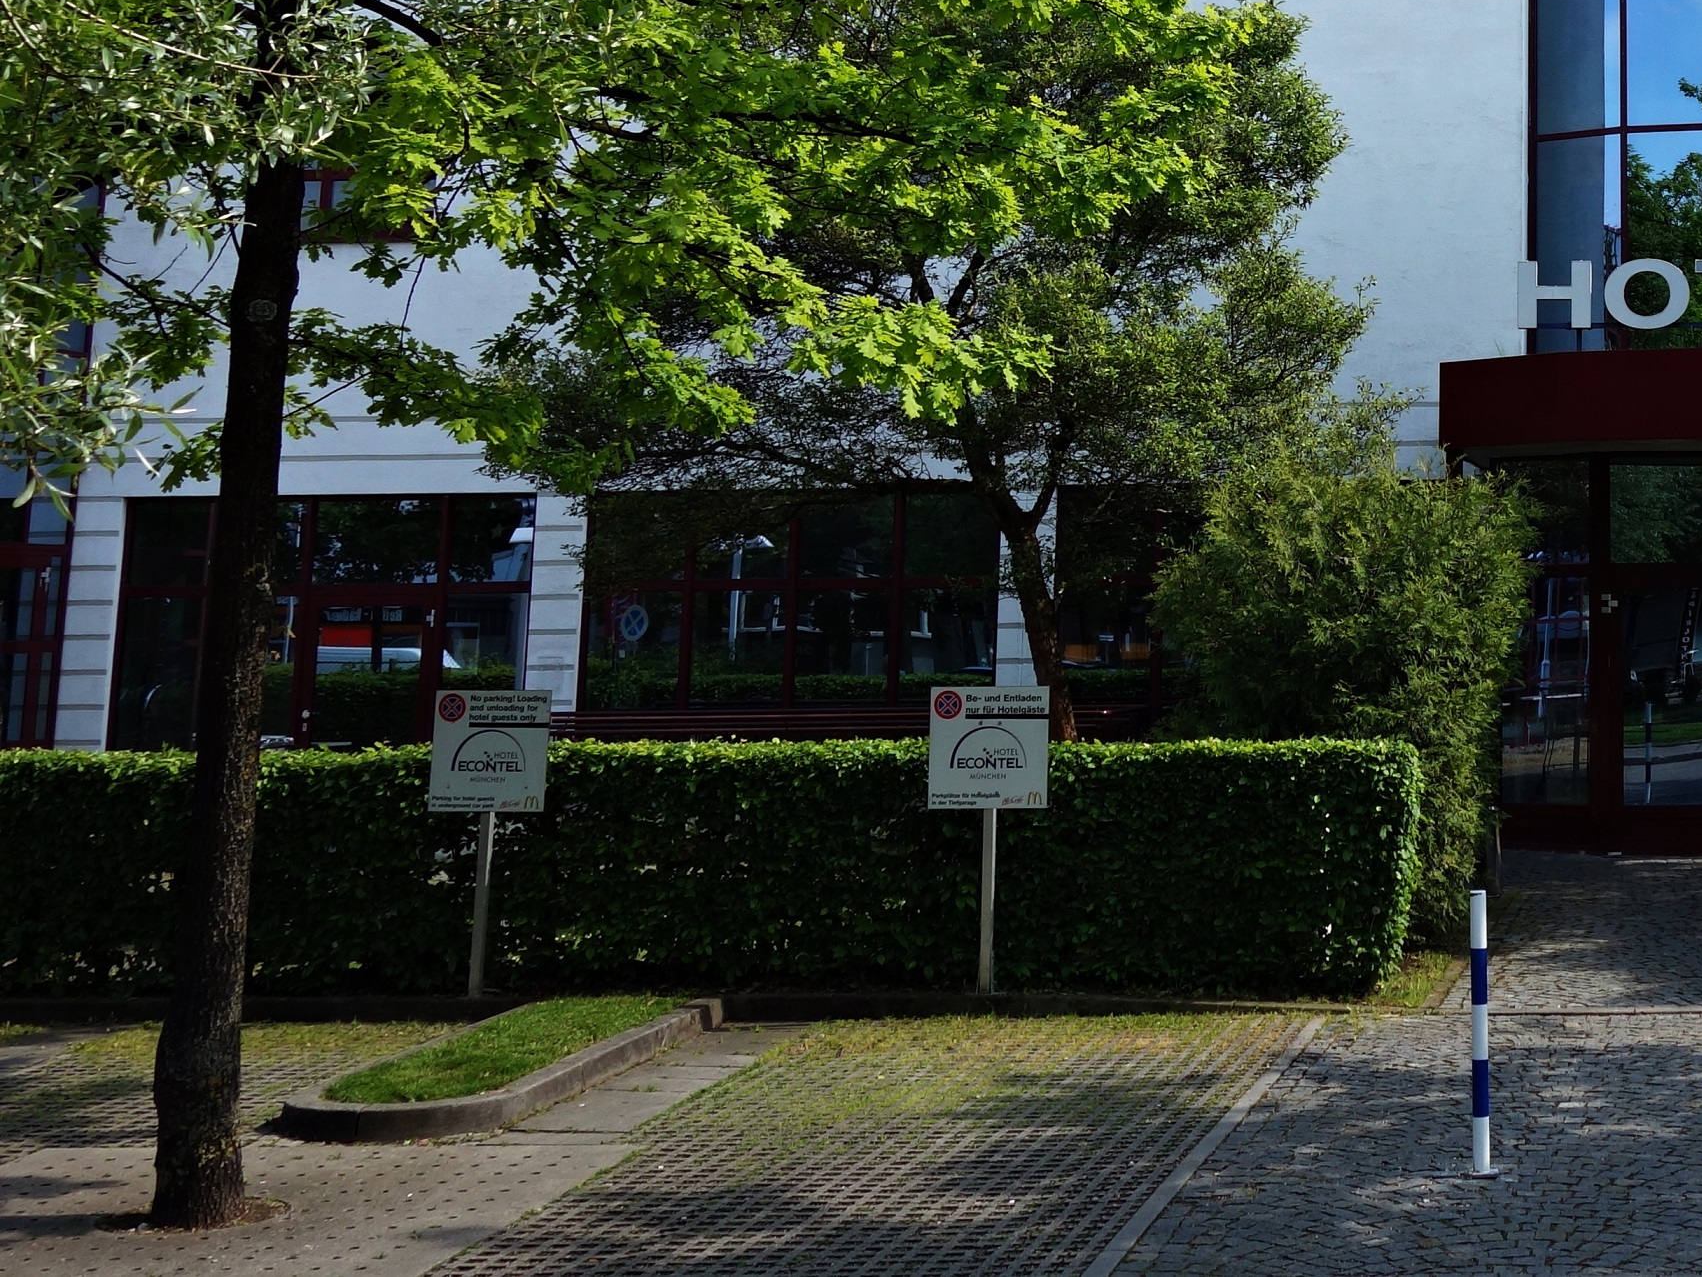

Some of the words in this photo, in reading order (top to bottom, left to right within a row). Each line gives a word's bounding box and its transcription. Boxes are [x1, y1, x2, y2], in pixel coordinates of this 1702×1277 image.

[484, 695, 515, 704] parking!
[517, 695, 547, 704] Loading
[486, 704, 524, 713] unloading
[998, 706, 1045, 714] Hotelgäste
[520, 714, 537, 722] only
[458, 761, 522, 773] ECONTEL
[957, 757, 1023, 770] ECONTEL
